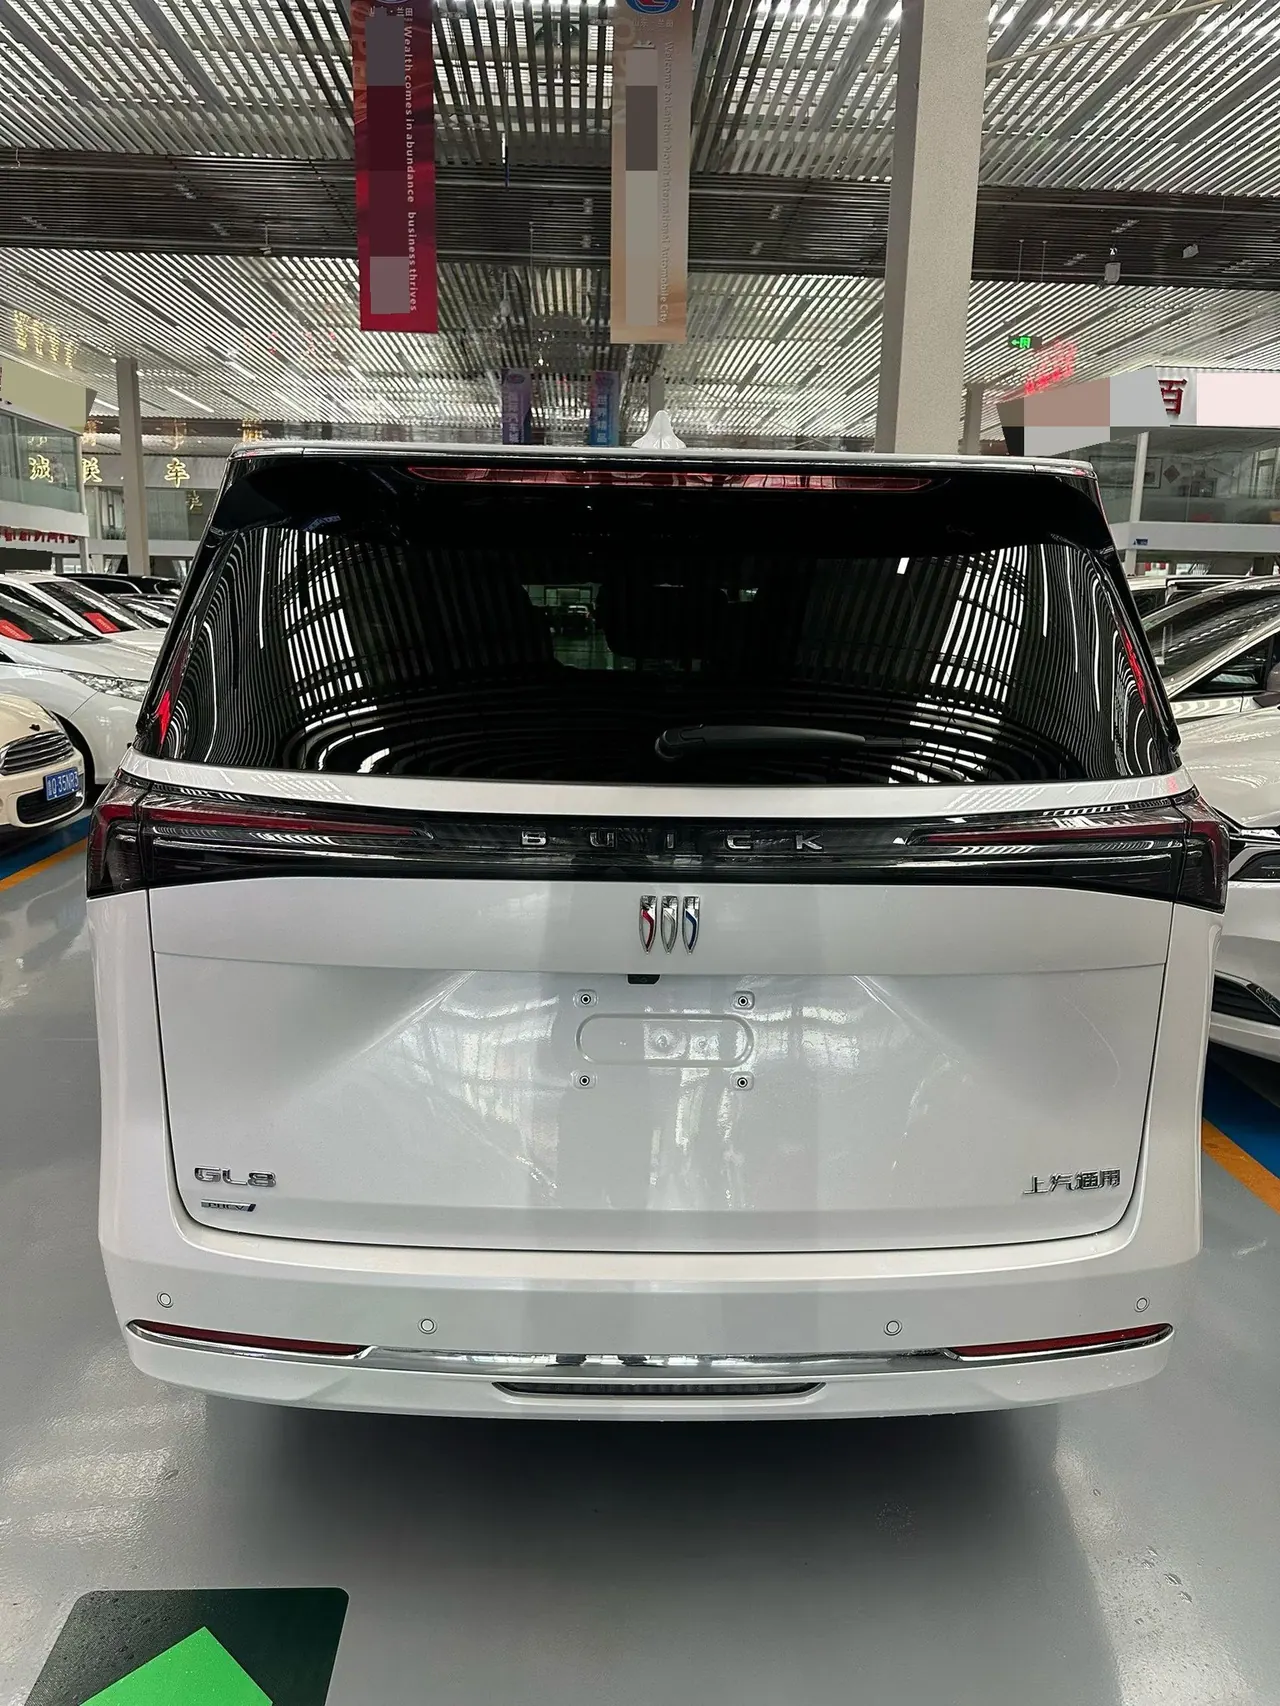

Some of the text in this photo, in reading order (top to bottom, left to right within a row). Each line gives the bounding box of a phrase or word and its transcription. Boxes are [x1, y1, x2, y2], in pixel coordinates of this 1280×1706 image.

[663, 41, 674, 89] Welcome
[664, 93, 673, 102] to
[404, 26, 419, 311] Wealth comes in abundance business thrives
[661, 178, 672, 243] International
[660, 247, 671, 302] Automobile
[659, 304, 669, 323] City
[1158, 378, 1188, 415] 百
[520, 830, 824, 851] BUICK
[194, 1165, 277, 1188] GL8
[1022, 1167, 1121, 1195] 上汽通用
